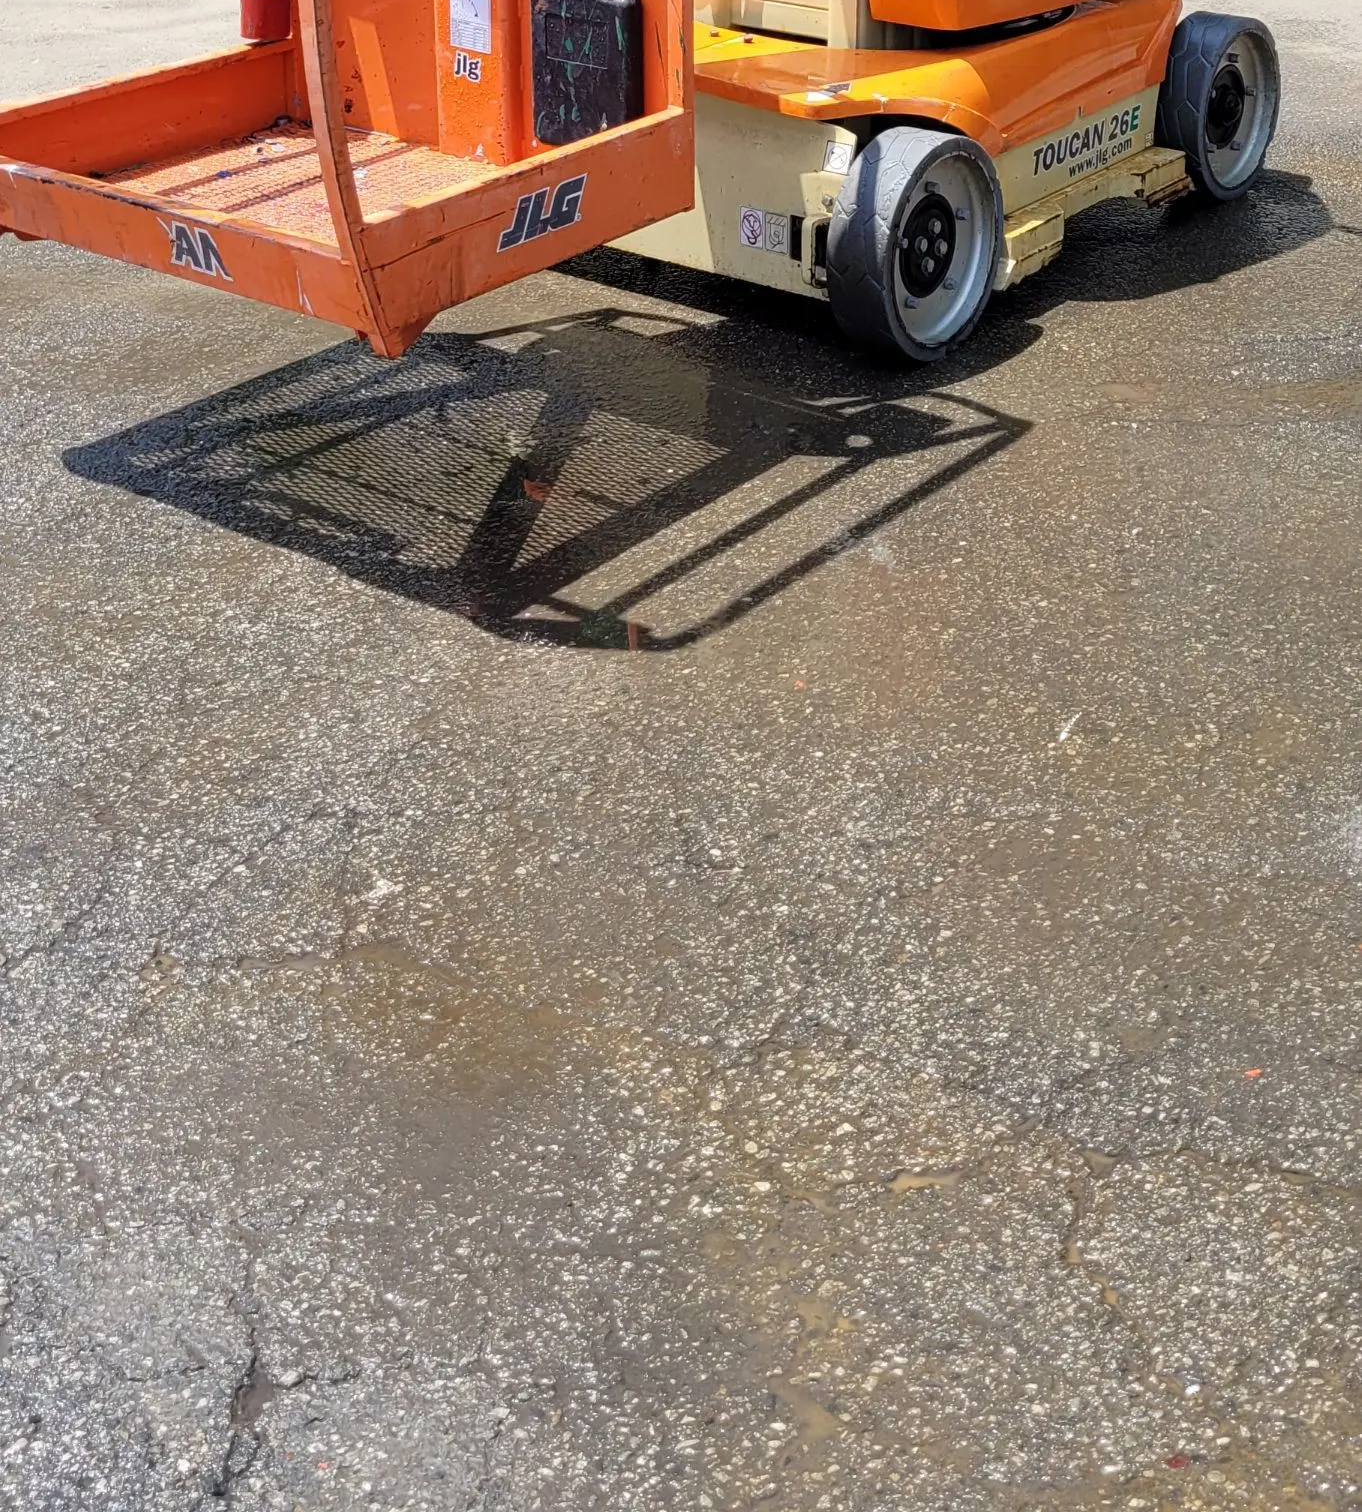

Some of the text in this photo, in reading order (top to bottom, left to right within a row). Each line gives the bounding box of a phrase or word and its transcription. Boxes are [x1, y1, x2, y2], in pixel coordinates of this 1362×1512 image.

[454, 53, 480, 81] jlg
[1033, 104, 1141, 176] TOUCAN 26E
[1069, 137, 1132, 178] www.jlg.com
[498, 173, 587, 252] JLG
